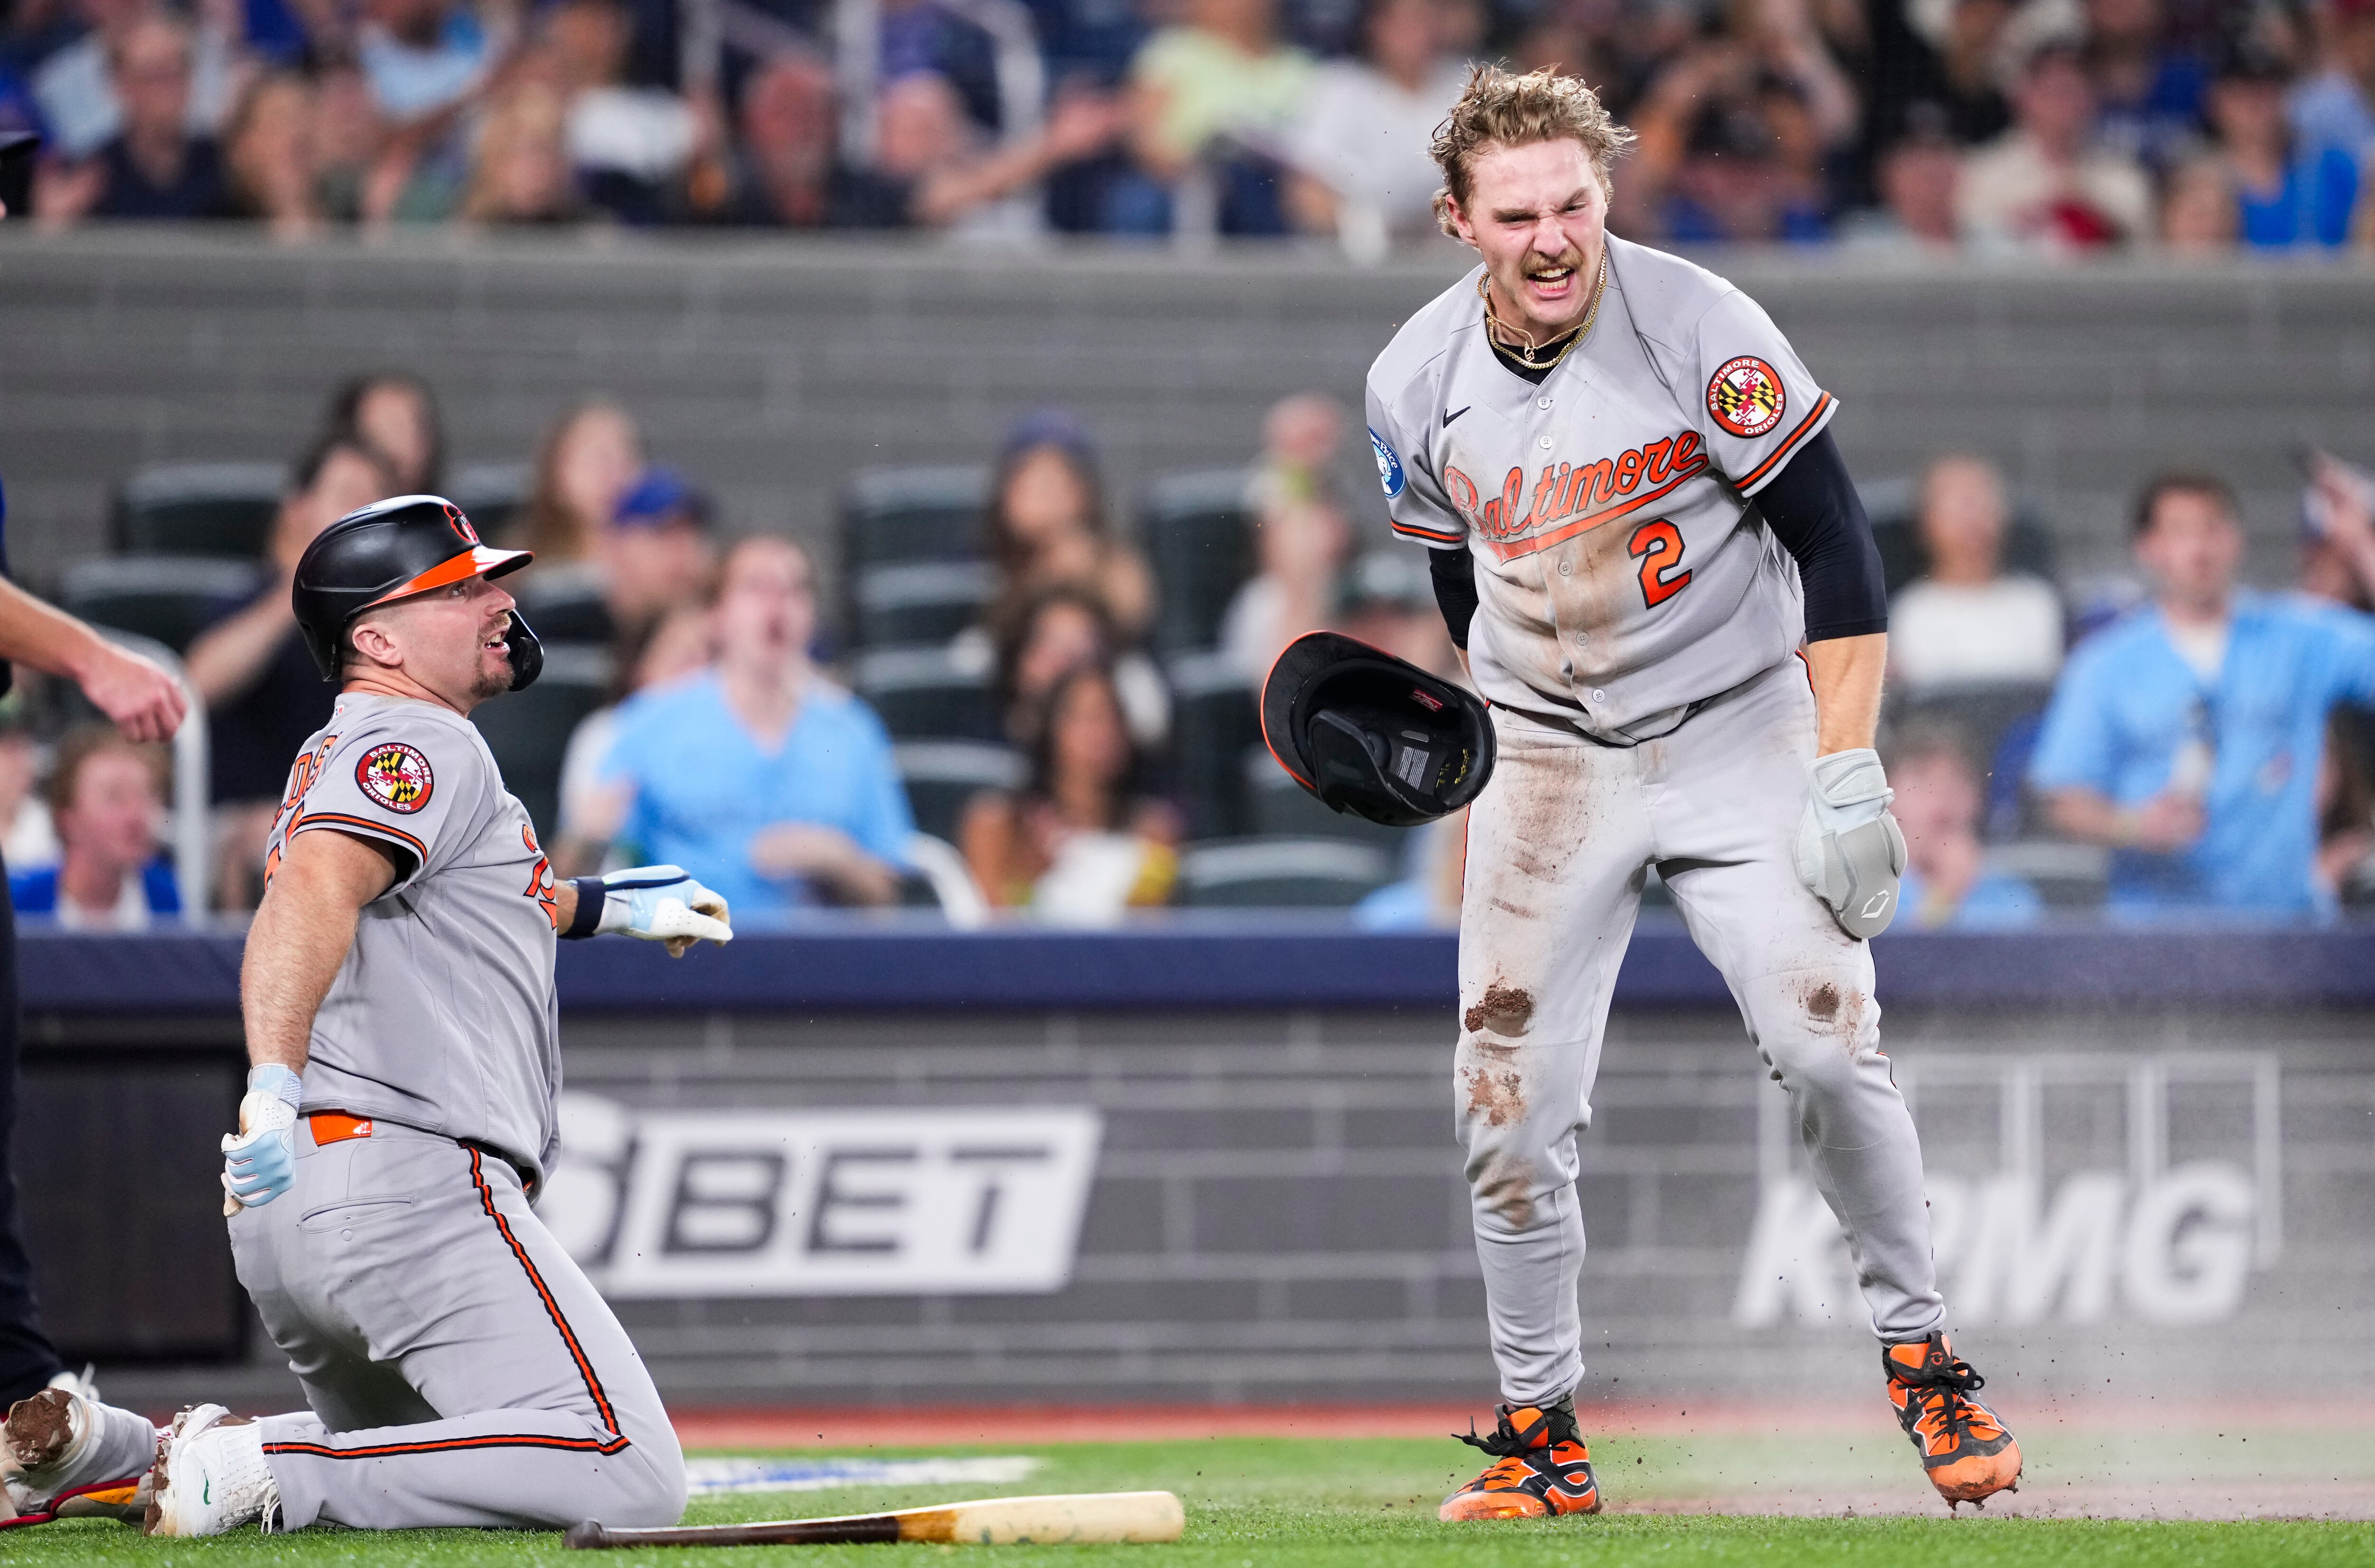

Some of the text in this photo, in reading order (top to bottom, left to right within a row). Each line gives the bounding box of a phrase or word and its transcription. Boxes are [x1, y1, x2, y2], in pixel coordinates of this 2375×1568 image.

[1711, 359, 1759, 411] BALTIMORE
[1744, 393, 1783, 435] ORIOLES
[1380, 441, 1398, 468] Price
[1444, 430, 1705, 538] Baltimore
[1626, 516, 1693, 610] 2
[369, 745, 432, 784] BALTIMORE
[362, 782, 411, 810] ORIOLES
